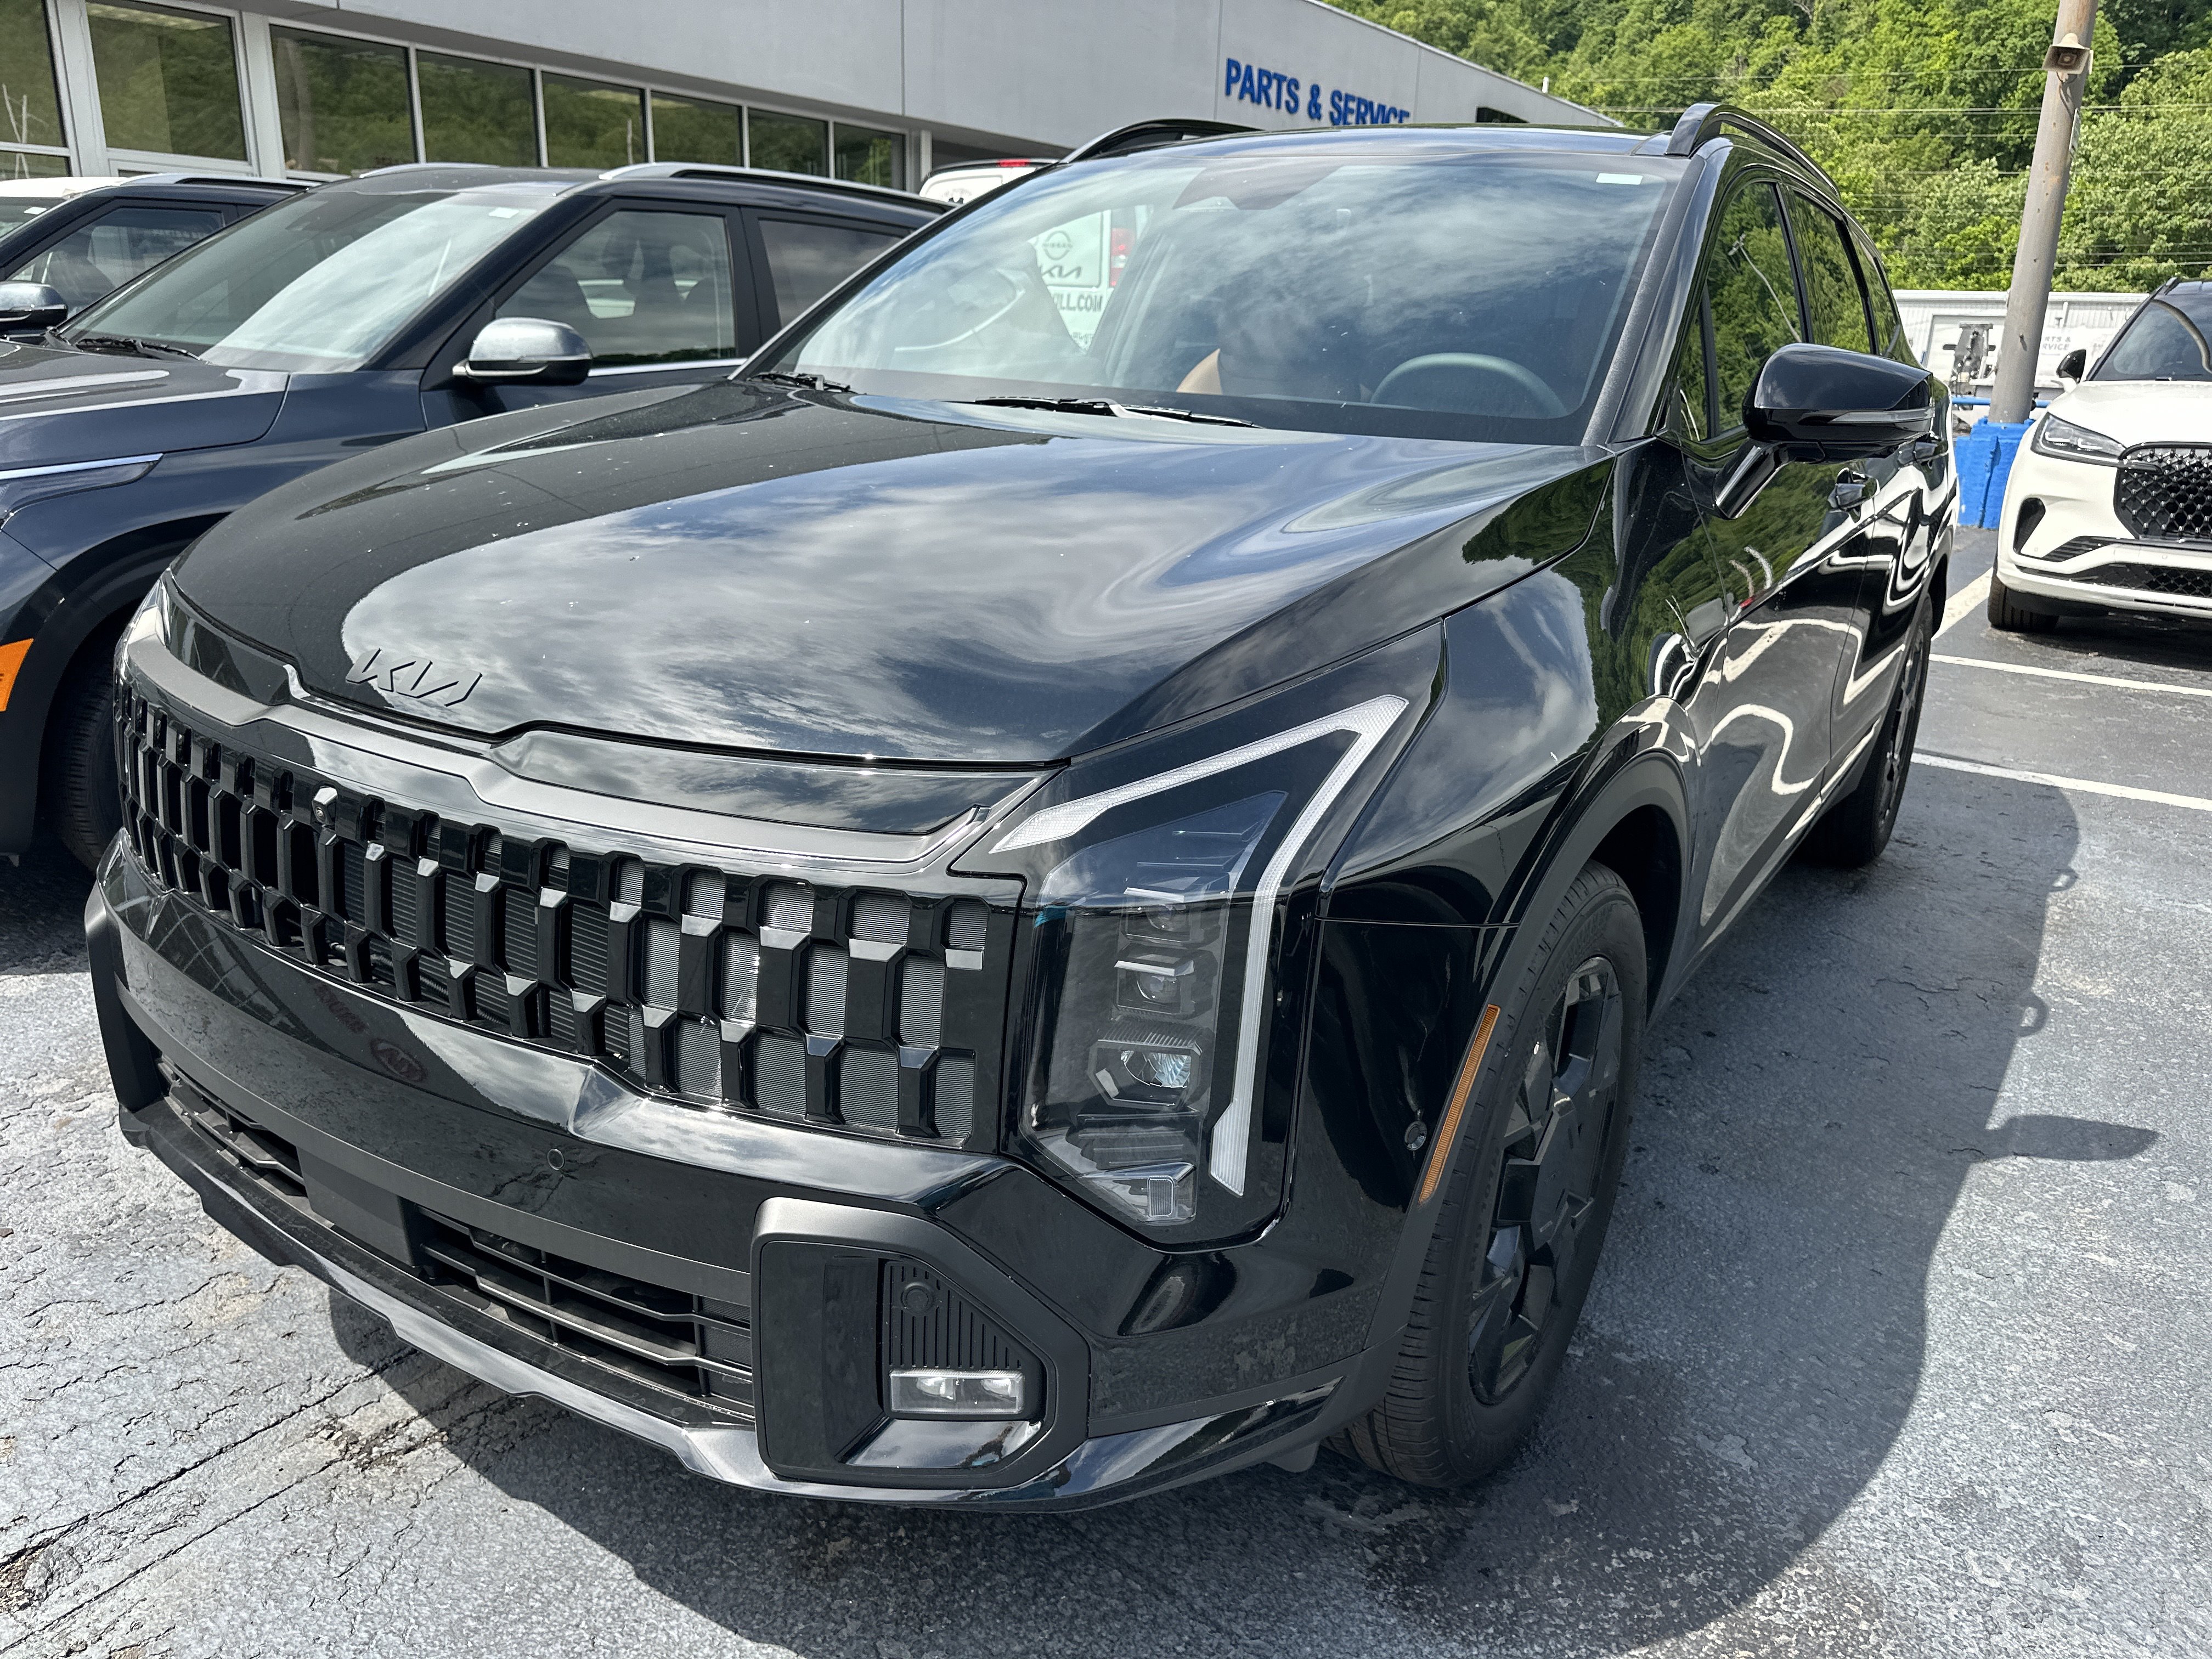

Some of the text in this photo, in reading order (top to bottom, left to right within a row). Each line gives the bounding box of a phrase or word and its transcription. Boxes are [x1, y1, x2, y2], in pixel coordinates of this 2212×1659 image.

[1225, 58, 1300, 114] PARTS
[1308, 83, 1322, 121] &
[346, 647, 483, 707] KIA
